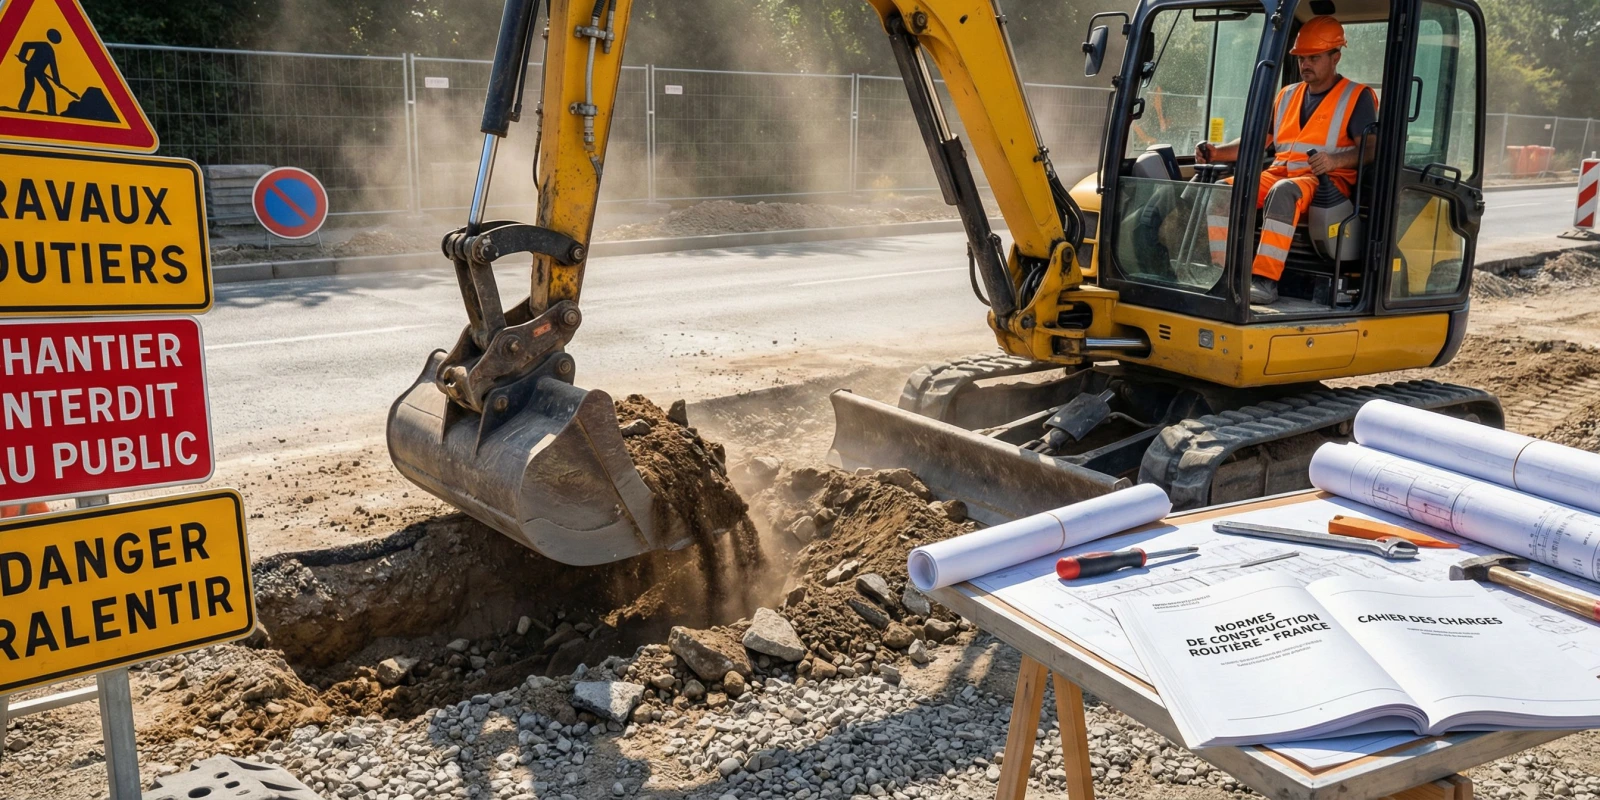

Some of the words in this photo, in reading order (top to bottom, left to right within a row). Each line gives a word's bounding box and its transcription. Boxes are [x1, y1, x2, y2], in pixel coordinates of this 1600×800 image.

[0, 240, 188, 285] UTIERS
[2, 333, 183, 376] HANTIER
[2, 382, 178, 430] NTERDIT
[0, 445, 36, 485] U
[52, 431, 198, 479] PUBLIC
[0, 522, 210, 597] DANGER
[0, 576, 234, 661] RALENTIR
[1186, 637, 1207, 647] DE
[1209, 613, 1320, 645] CONSTRUCTION
[1188, 637, 1263, 657] ROUTIÈRE
[1273, 622, 1332, 642] FRANCE
[1214, 612, 1276, 633] NORMES
[1357, 613, 1409, 624] CAHIER
[1409, 615, 1437, 625] DES
[1438, 617, 1503, 626] CHARGES
